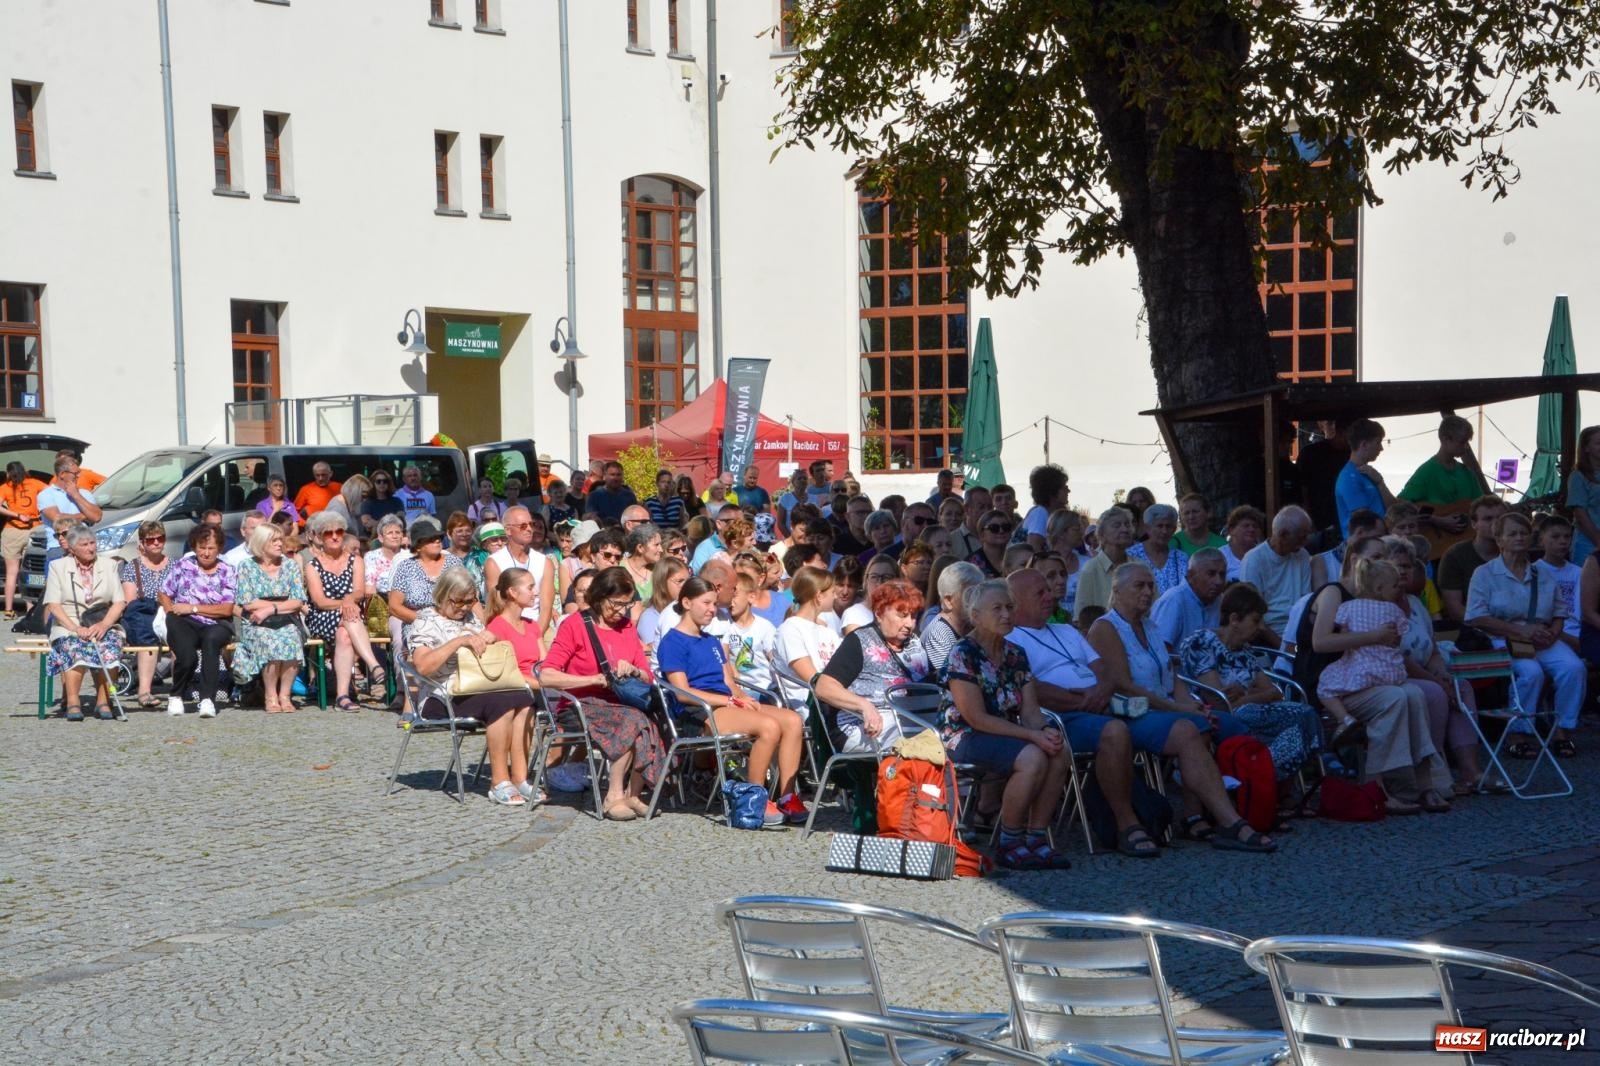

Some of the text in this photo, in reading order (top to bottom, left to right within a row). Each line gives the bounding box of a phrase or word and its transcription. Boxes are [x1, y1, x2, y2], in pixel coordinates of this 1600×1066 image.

[448, 338, 498, 349] MASZYNOWNIA
[729, 385, 751, 488] ASZYNOWNIA
[763, 440, 789, 450] Zamkow
[1500, 461, 1515, 480] 5
[21, 490, 32, 507] 5
